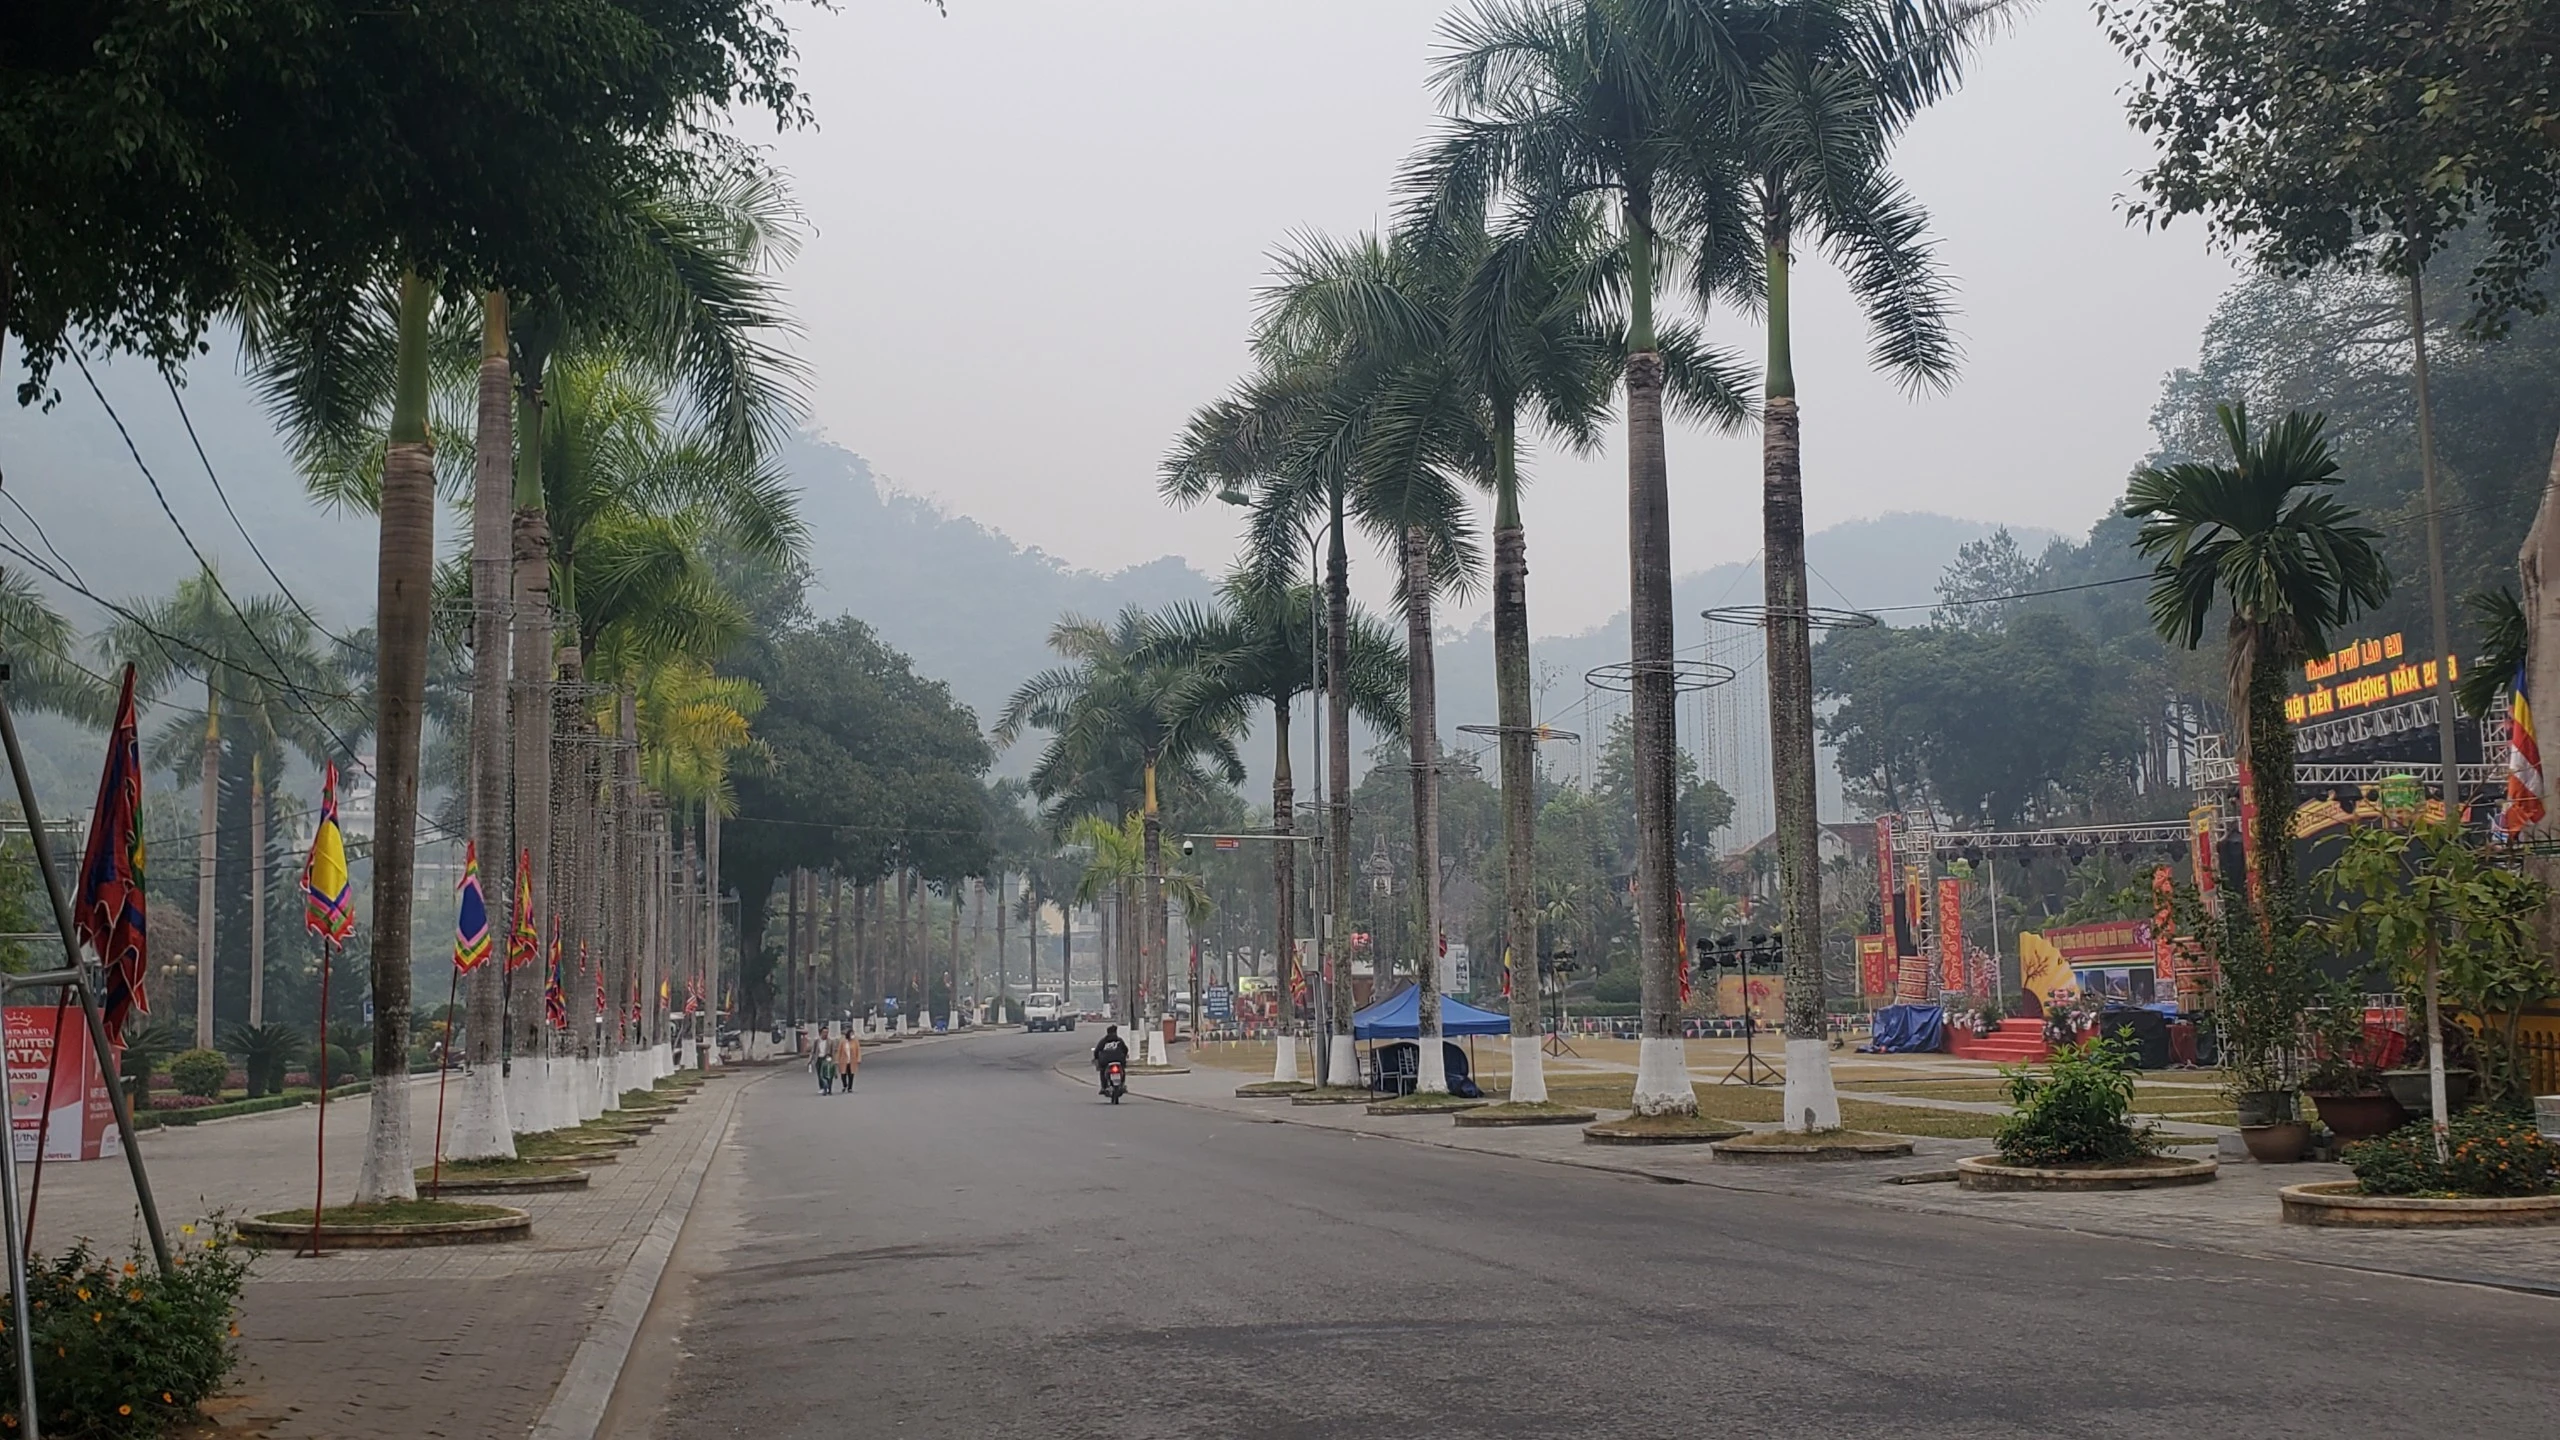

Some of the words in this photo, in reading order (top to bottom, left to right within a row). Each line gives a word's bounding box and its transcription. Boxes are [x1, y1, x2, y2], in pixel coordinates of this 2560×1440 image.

[2338, 638, 2360, 672] PHỐ
[2361, 638, 2382, 666] LÀO
[2384, 632, 2403, 659] CAI
[2308, 682, 2334, 716] ĐỀN
[2337, 675, 2388, 707] THƯỢNG
[2390, 663, 2422, 696] NĂM
[7, 1049, 47, 1063] ATA
